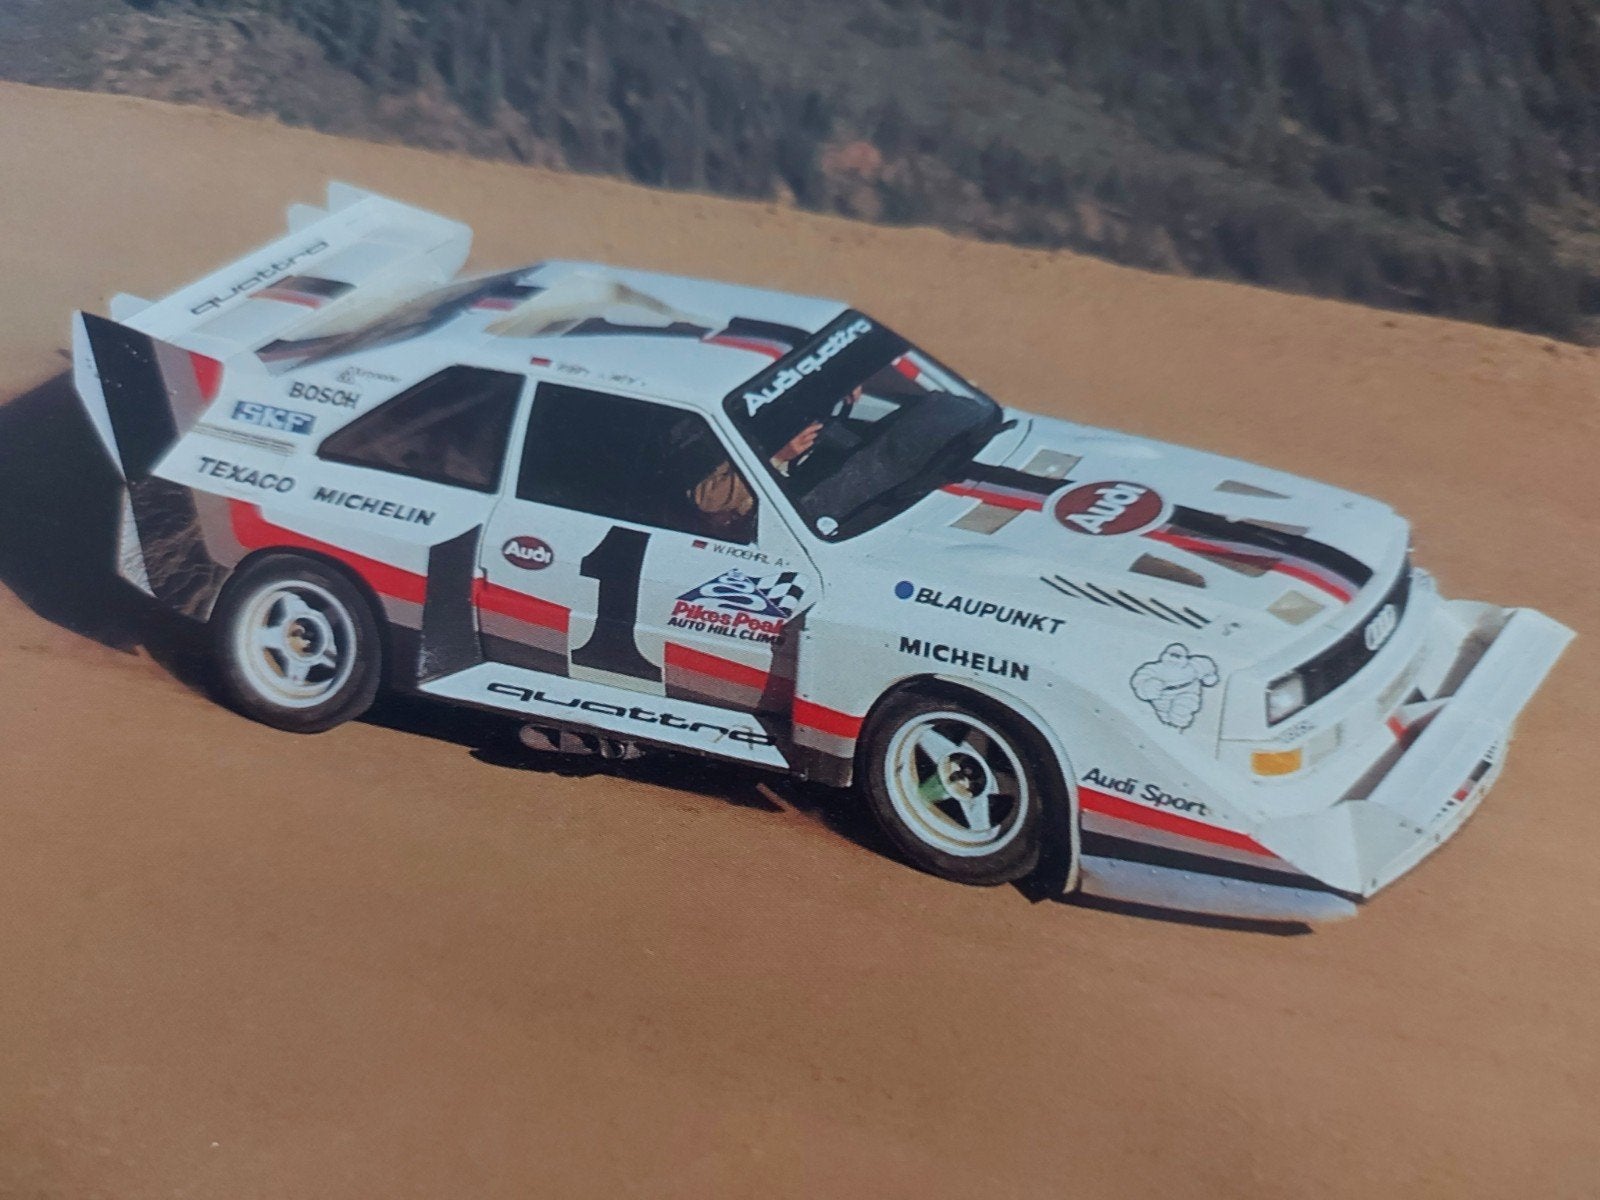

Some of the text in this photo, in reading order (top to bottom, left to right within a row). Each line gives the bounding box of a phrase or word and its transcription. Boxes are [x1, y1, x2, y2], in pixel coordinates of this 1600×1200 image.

[190, 240, 330, 315] quattro
[742, 319, 872, 417] Audi quattro
[235, 402, 313, 433] SKF
[288, 381, 361, 409] BOSCH
[199, 456, 437, 526] TEXACO MICHELIN
[1065, 483, 1148, 534] Audi
[503, 540, 552, 564] Audi
[571, 525, 663, 683] 1
[667, 616, 707, 632] AUTO
[707, 623, 738, 638] HILL
[671, 600, 732, 626] Pikes
[914, 587, 1066, 634] BLAUPUNKT
[899, 635, 1030, 682] MICHELIN
[486, 682, 778, 748] quattro
[1081, 767, 1208, 817] Audi Sport
